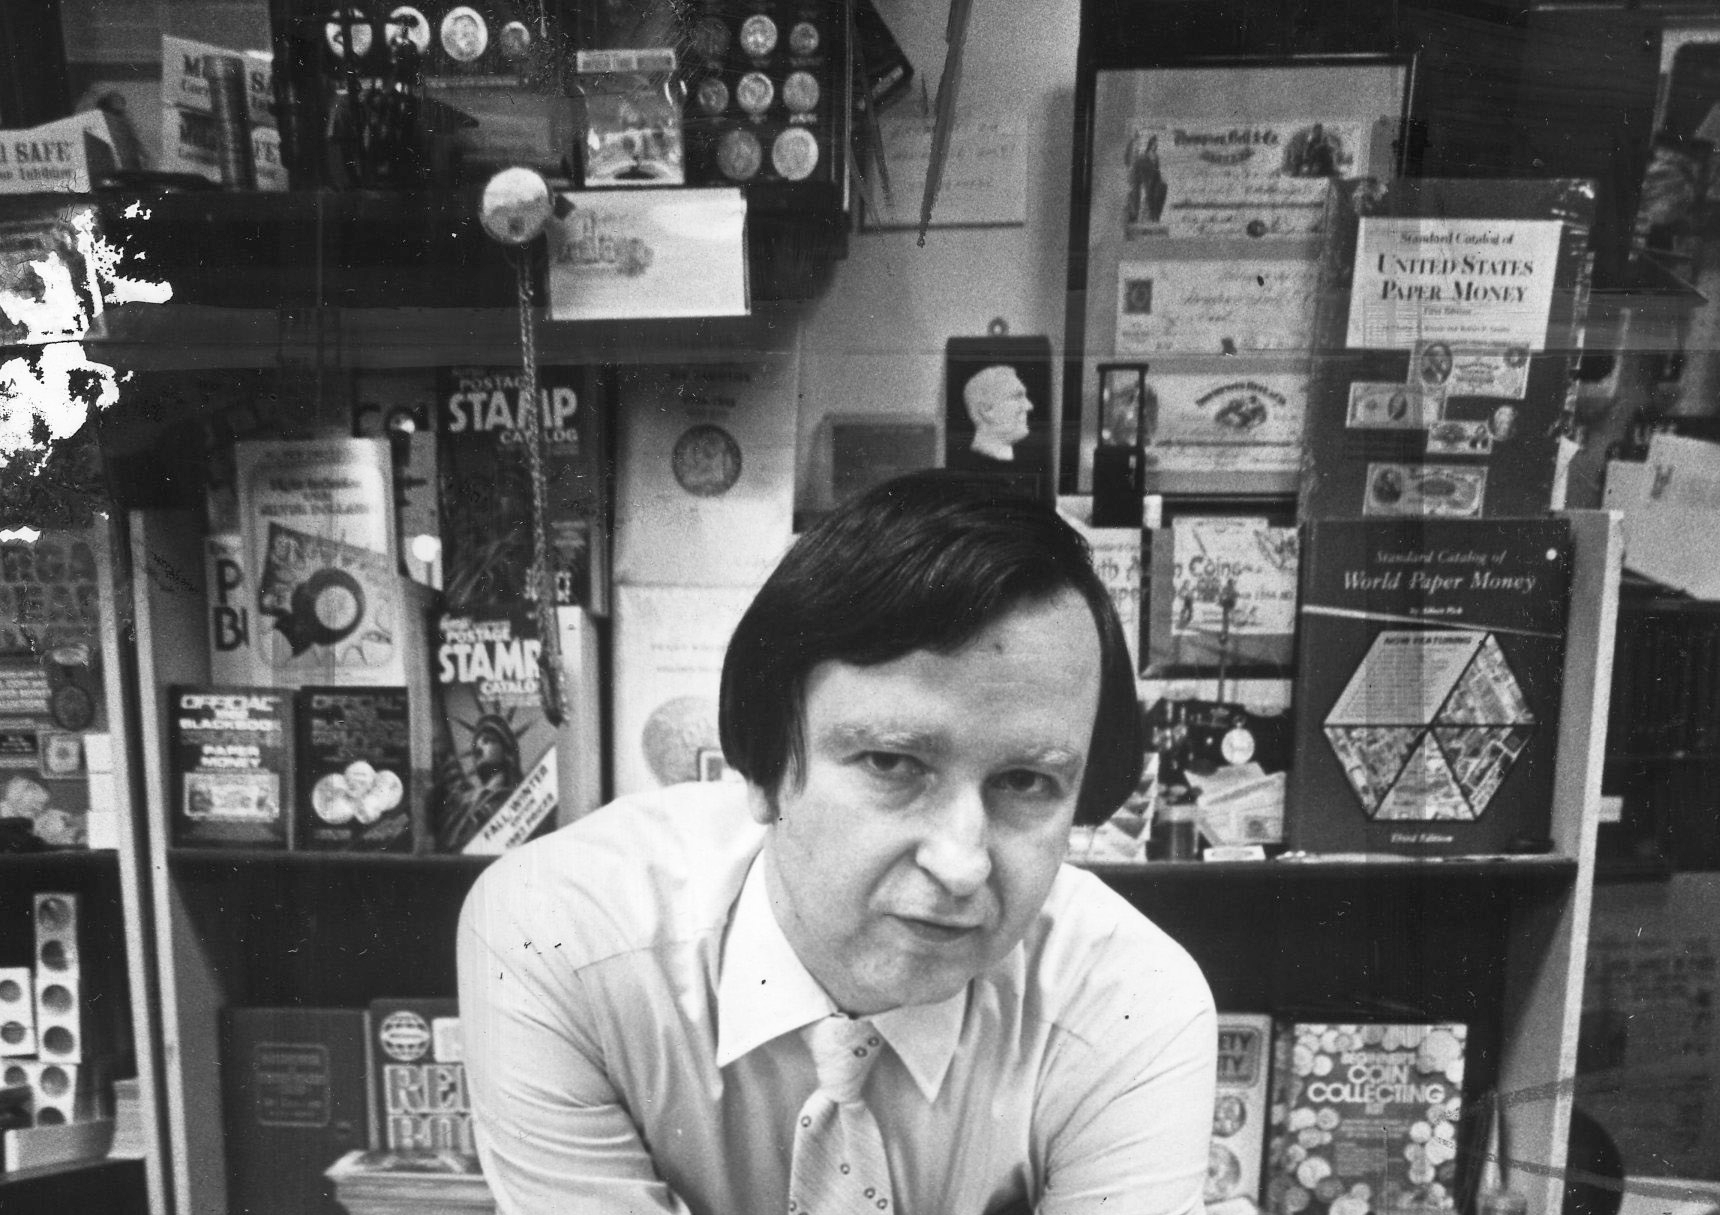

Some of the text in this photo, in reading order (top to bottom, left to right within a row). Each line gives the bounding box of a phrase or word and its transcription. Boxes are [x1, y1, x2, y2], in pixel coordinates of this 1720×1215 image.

[1400, 231, 1514, 247] Standard Catalog of
[1378, 253, 1534, 276] UNITED STATES
[1381, 279, 1529, 303] PAPER MONEY
[449, 387, 578, 432] STAMP
[1376, 549, 1508, 566] Standard Catalog of
[1344, 570, 1537, 596] World Paper Money
[1347, 1064, 1410, 1085] COIN
[1307, 1081, 1446, 1104] COLLECTING
